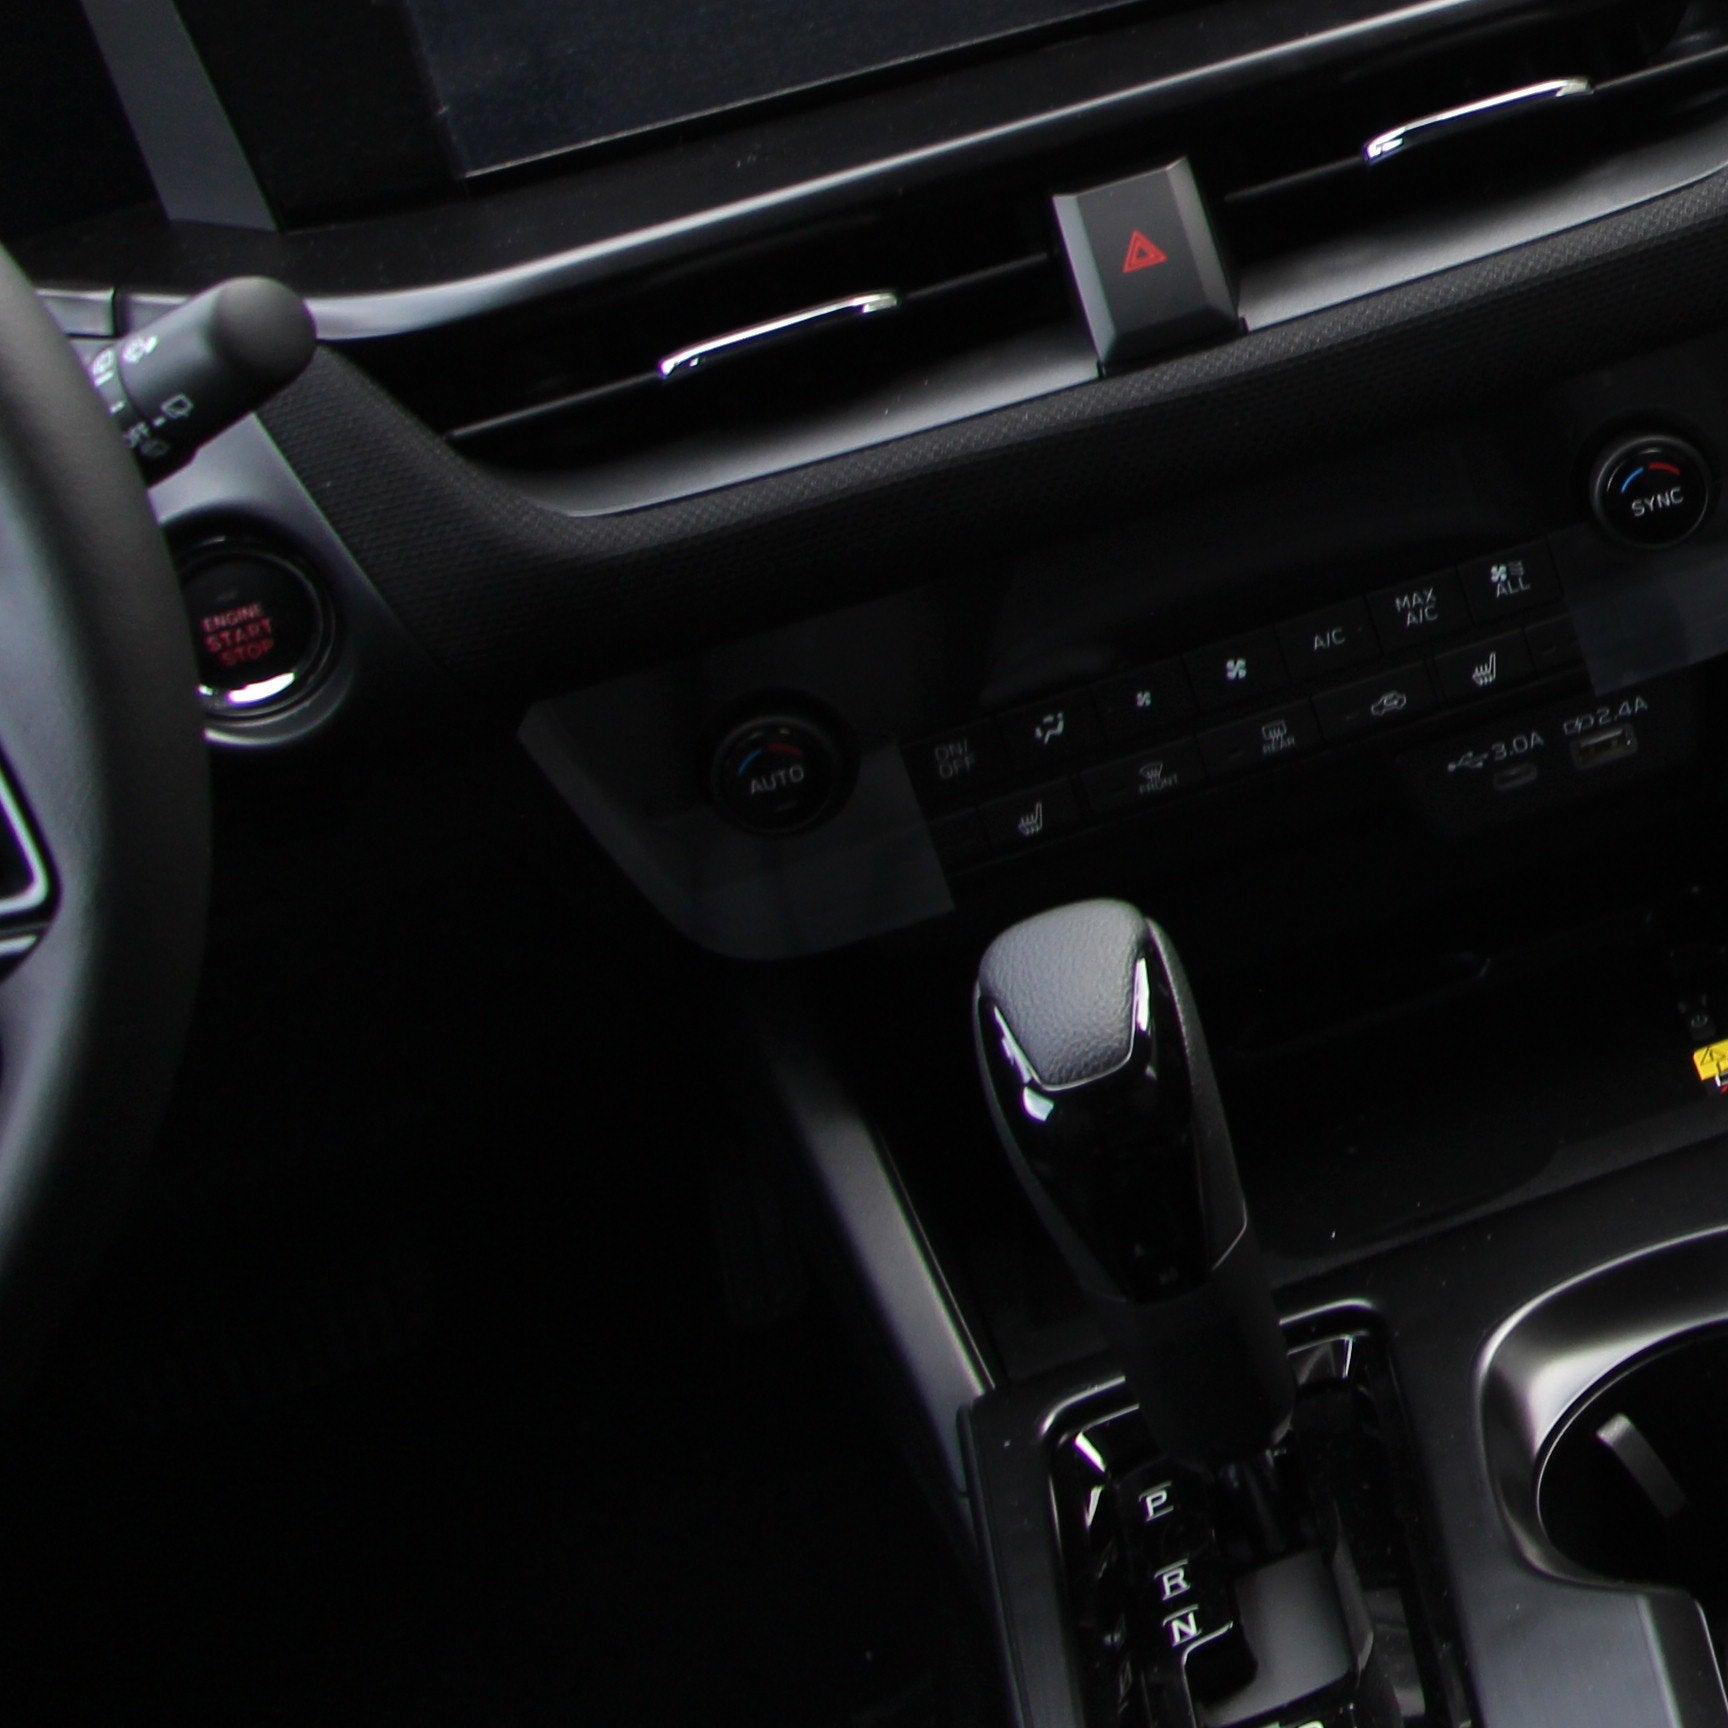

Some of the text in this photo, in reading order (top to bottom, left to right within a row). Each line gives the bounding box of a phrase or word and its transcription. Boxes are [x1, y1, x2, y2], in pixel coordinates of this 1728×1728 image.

[1631, 487, 1684, 517] SYNC
[1395, 588, 1436, 612] MAX
[1495, 578, 1531, 599] ALL
[202, 603, 261, 632] ENGINE
[1406, 605, 1438, 628] A/C
[205, 618, 272, 653] START
[1313, 628, 1346, 651] A/C
[218, 637, 274, 667] STOP
[1597, 697, 1649, 725] 2.4A
[1491, 733, 1544, 761] 3.0A
[750, 765, 806, 795] AUTO
[939, 753, 974, 779] OFF
[1144, 1489, 1169, 1520] P
[1162, 1567, 1190, 1599] R
[1170, 1611, 1200, 1646] N
